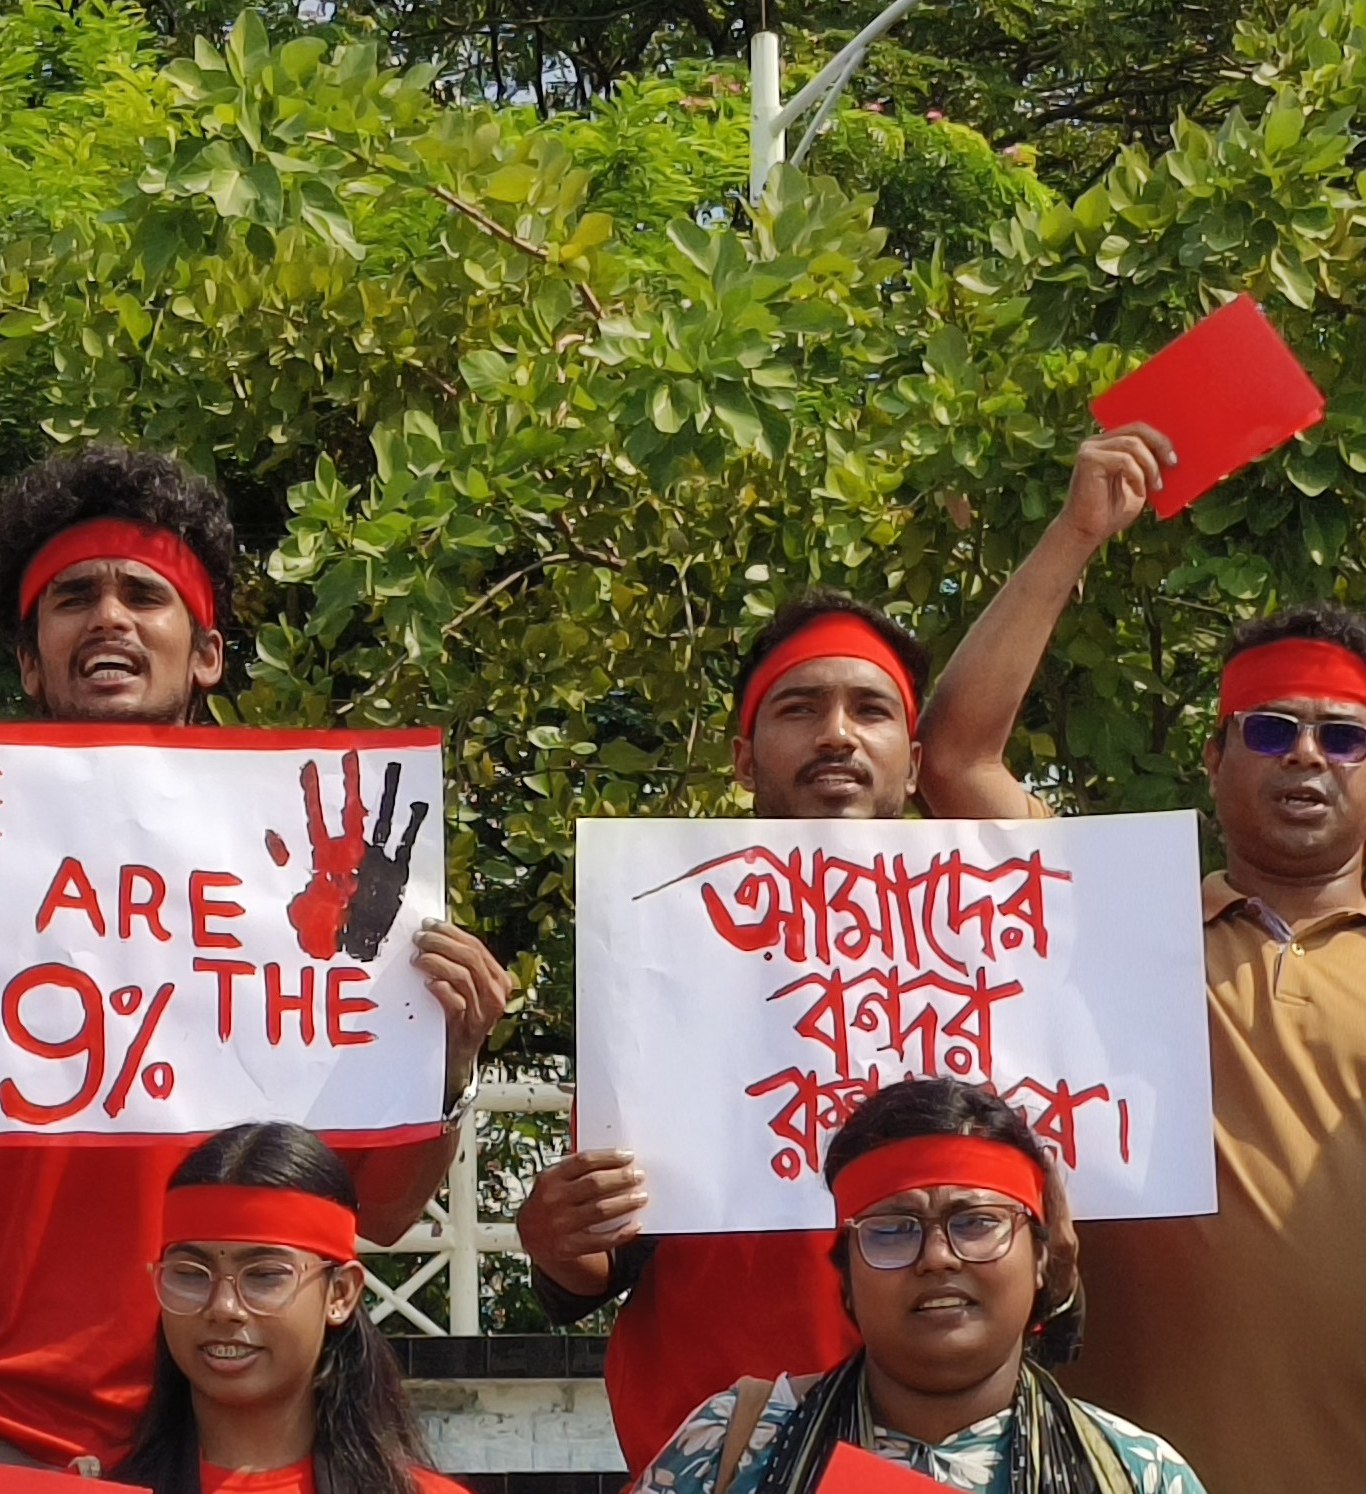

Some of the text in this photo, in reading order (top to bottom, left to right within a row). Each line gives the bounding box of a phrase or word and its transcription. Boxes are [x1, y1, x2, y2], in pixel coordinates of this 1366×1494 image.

[35, 856, 245, 950] ARE
[632, 846, 1072, 976] আমাদের
[193, 958, 380, 1047] THE
[766, 966, 1023, 1080] বন্দর
